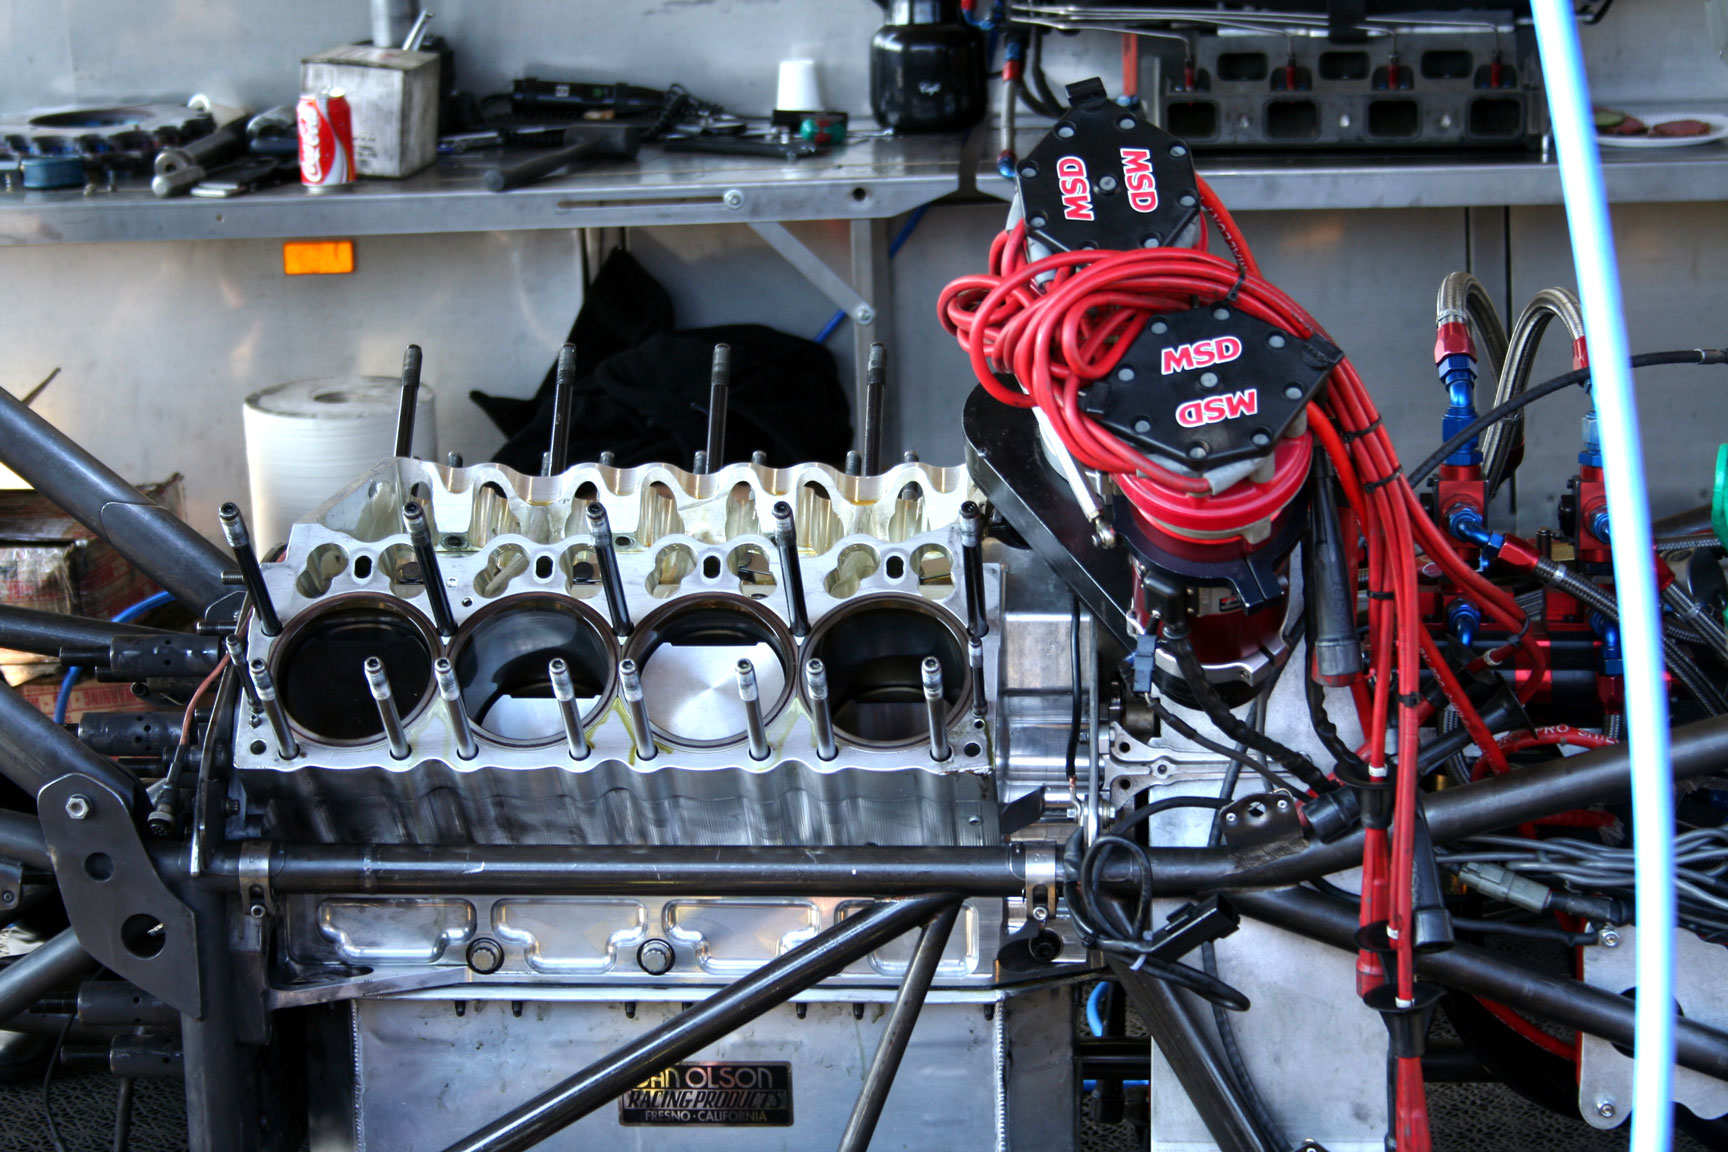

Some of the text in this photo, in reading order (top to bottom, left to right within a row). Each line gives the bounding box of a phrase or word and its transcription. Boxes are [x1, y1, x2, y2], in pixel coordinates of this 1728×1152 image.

[1057, 156, 1094, 221] MSD
[1120, 148, 1158, 213] MSD
[1161, 336, 1242, 375] MSD
[1176, 389, 1257, 428] MSD
[685, 1067, 773, 1089] OLSON
[628, 1090, 784, 1109] RACING PRODUCTS
[645, 1111, 767, 1121] FRESNO CALIFORNIA
